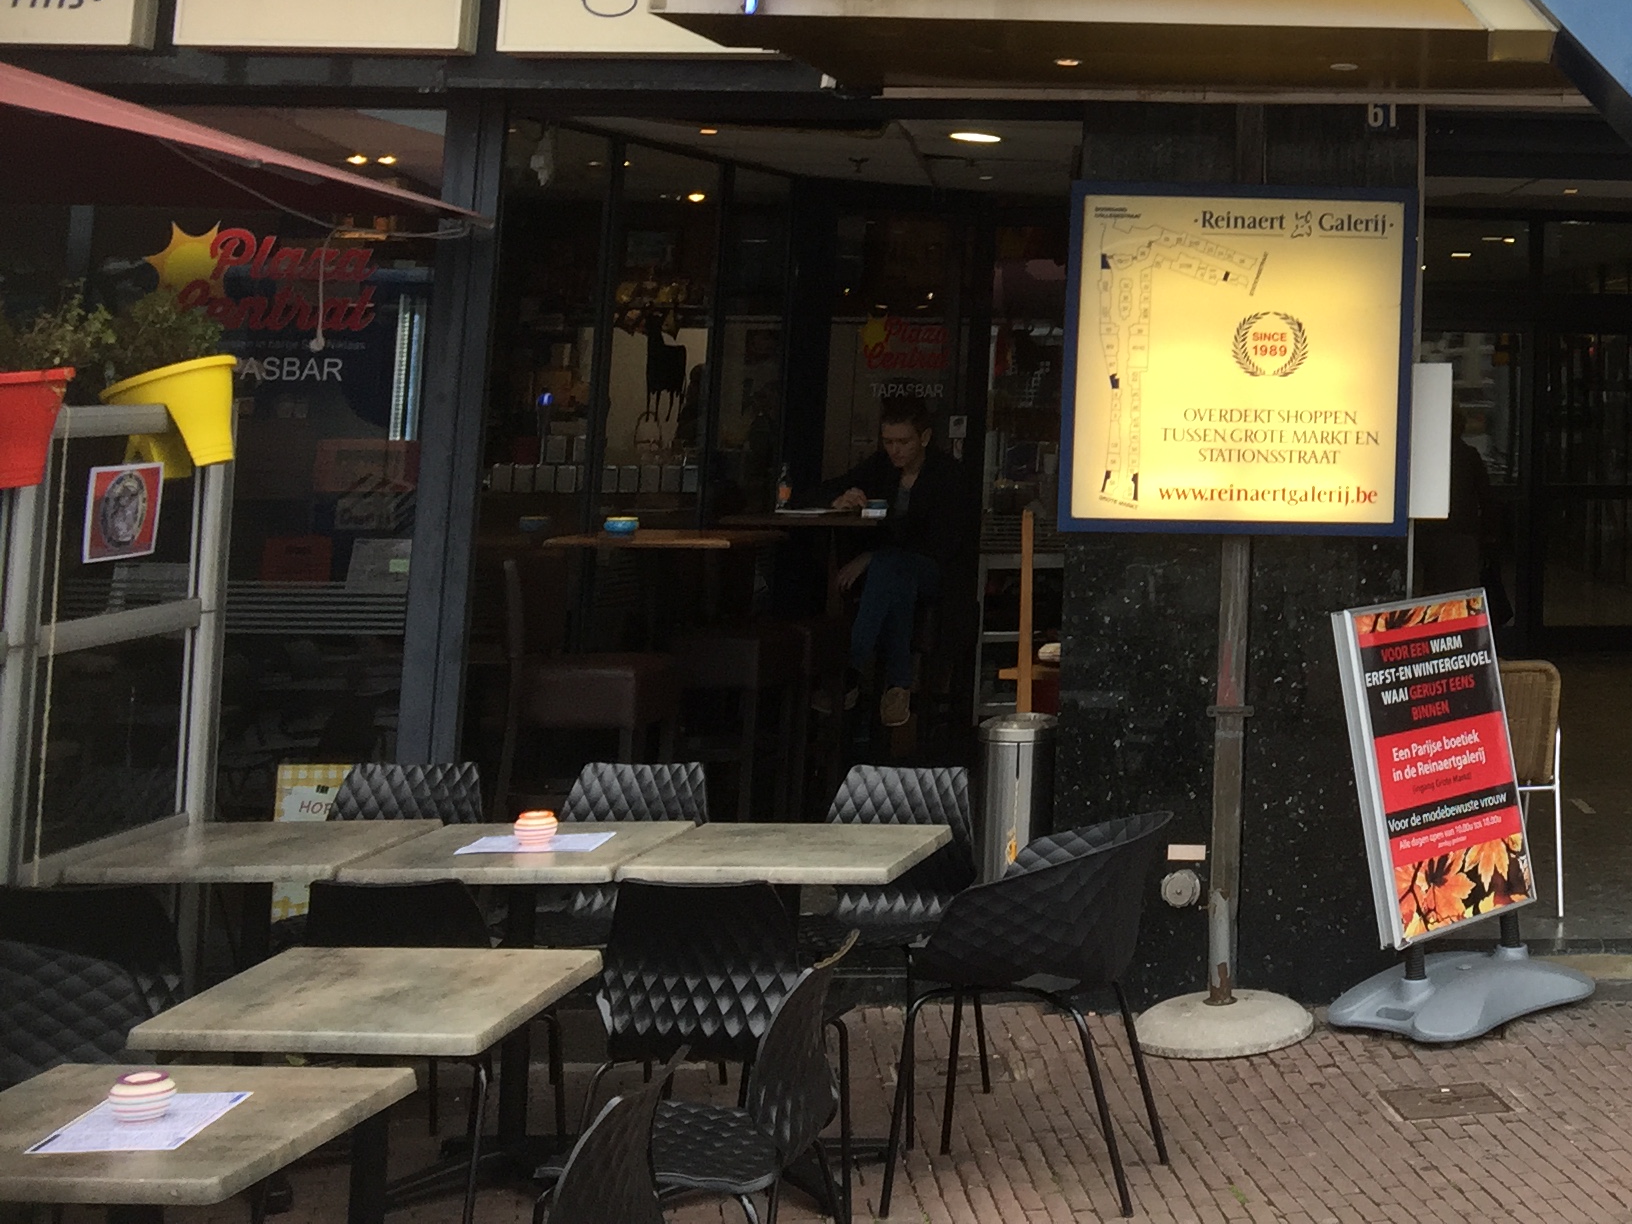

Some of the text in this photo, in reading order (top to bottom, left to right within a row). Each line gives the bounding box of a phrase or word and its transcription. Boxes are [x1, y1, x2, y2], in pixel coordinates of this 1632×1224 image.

[1200, 209, 1388, 236] Reinaert Galerij
[210, 227, 378, 281] Plaza
[1252, 331, 1287, 342] SINCE
[1252, 344, 1288, 357] 1989
[236, 357, 343, 382] ASBAR
[1183, 408, 1357, 426] OVERDEKT SHOPPEN
[1161, 427, 1380, 447] TUSSEN GROTE MARKT EN
[1198, 447, 1341, 465] STATIONSSTRAAT
[1159, 483, 1378, 507] www.reinaertgalerij.be
[1380, 635, 1463, 663] VOOR EEN WARM
[1412, 650, 1492, 678] WINTERGEVOEL
[1381, 674, 1476, 705] WAAI GERUST EENS
[1411, 700, 1450, 720] BINNEN
[1392, 729, 1480, 762] Een Parijse boetiek
[1392, 746, 1486, 782] in de Reinaertgalerij
[1388, 792, 1508, 833] Voor de modebewuste vrouw
